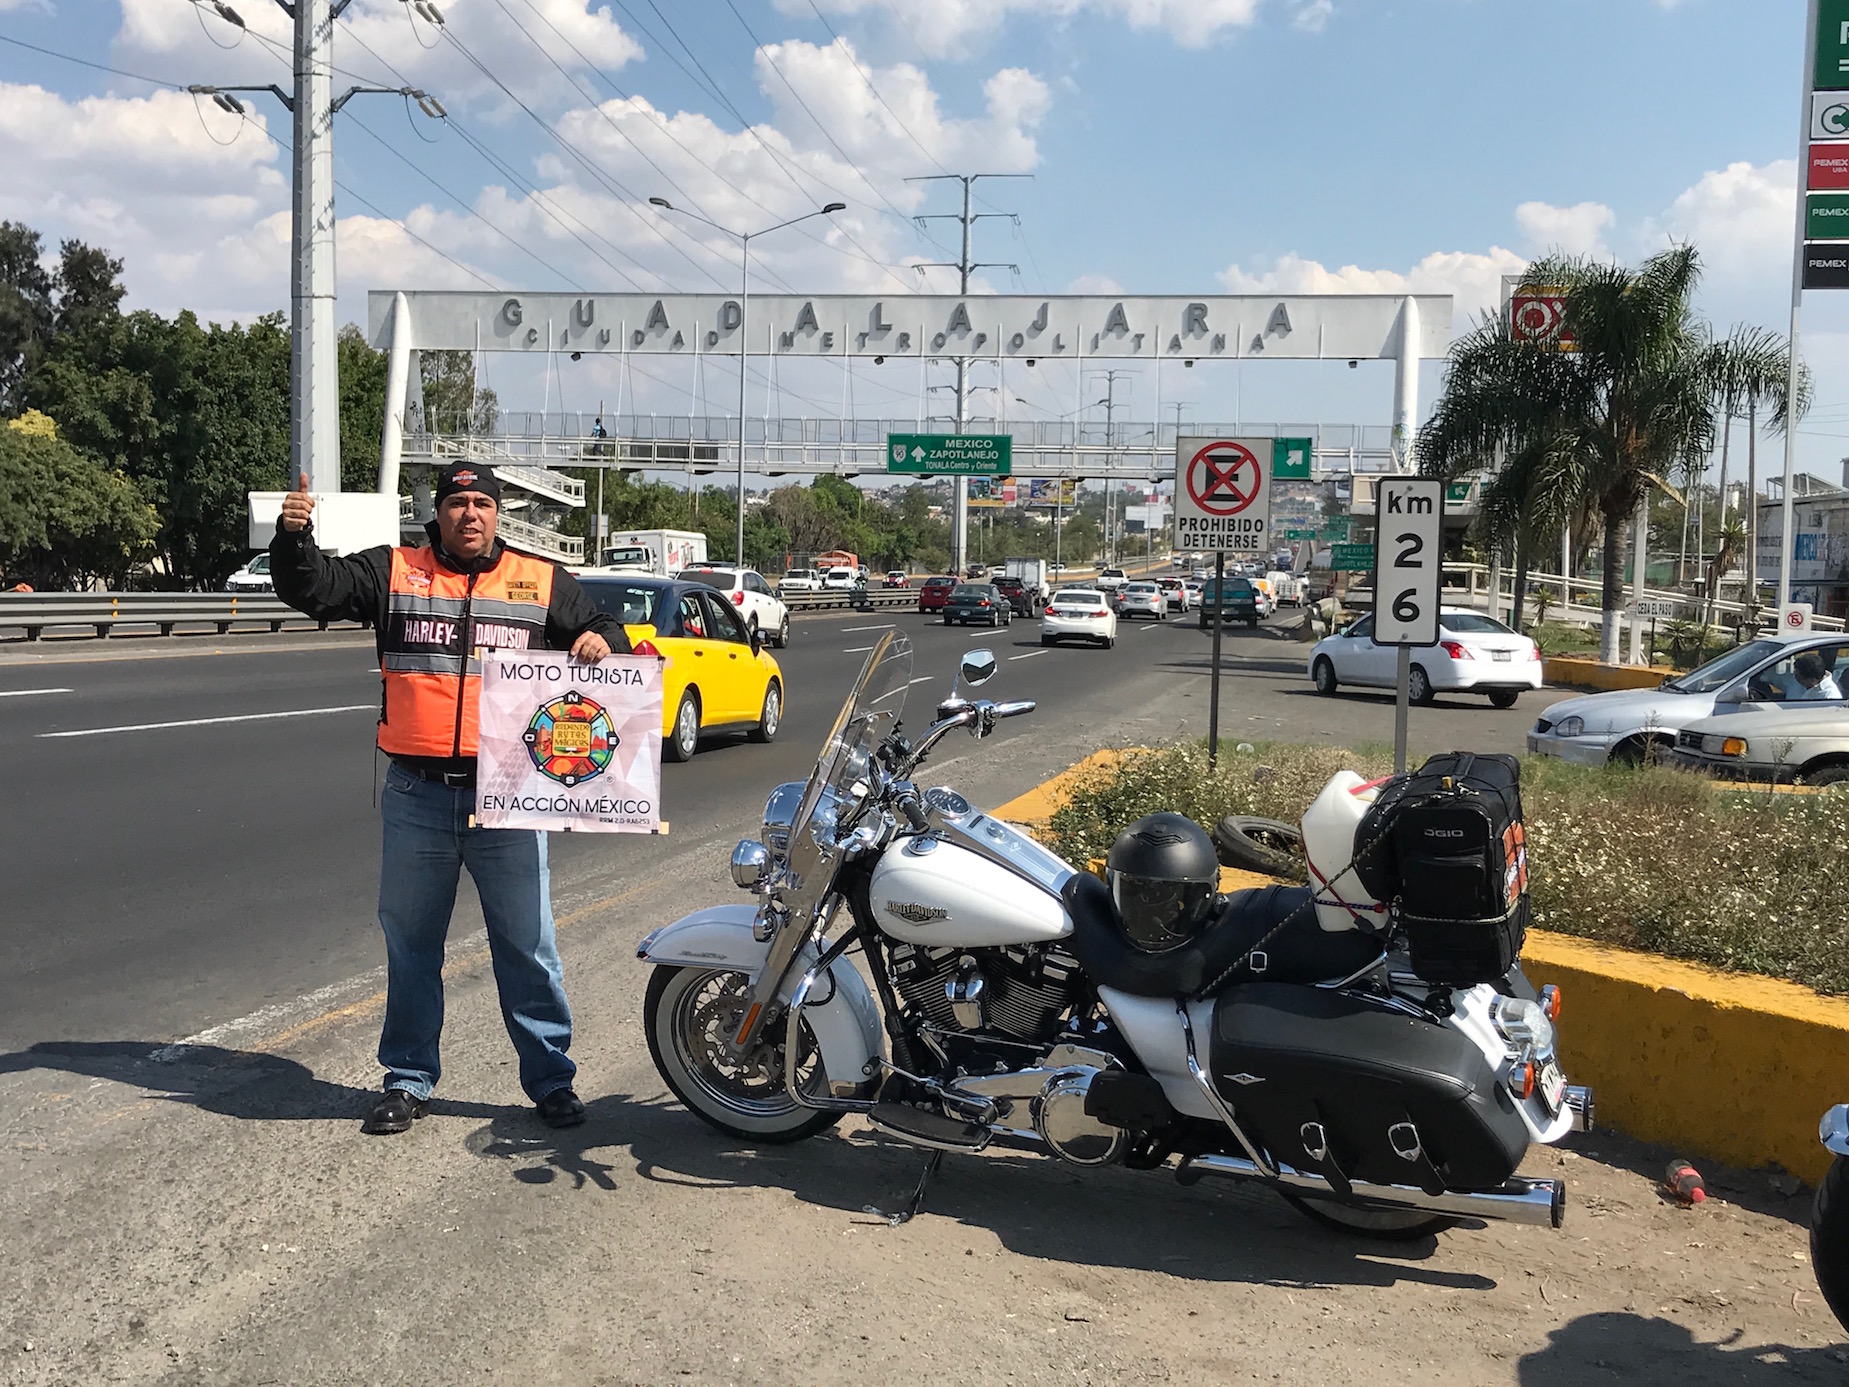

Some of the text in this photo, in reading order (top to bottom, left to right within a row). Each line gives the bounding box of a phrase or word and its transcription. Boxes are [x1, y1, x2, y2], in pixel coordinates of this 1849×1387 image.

[1813, 158, 1849, 167] PEMEX
[1812, 208, 1849, 217] PEMEX
[1809, 259, 1847, 268] PEMEX
[502, 298, 1293, 333] GUADALAJARA
[527, 328, 1266, 351] CIUDAD METROPOLITANA
[945, 439, 993, 449] MEXICO
[929, 449, 999, 460] ZAPOTLANEJO
[925, 461, 950, 470] TONALA
[950, 461, 969, 470] Centro
[976, 461, 997, 470] Oriente
[1387, 489, 1433, 515] km
[1179, 517, 1264, 533] PROHIBIDO
[1183, 533, 1259, 549] DETENERSE
[1393, 532, 1424, 569] 2
[1392, 588, 1421, 623] 6
[475, 623, 530, 650] DAVIDSON
[500, 662, 644, 686] MOTO TURISTA
[483, 794, 651, 814] EN ACCIÓN MÉXICO
